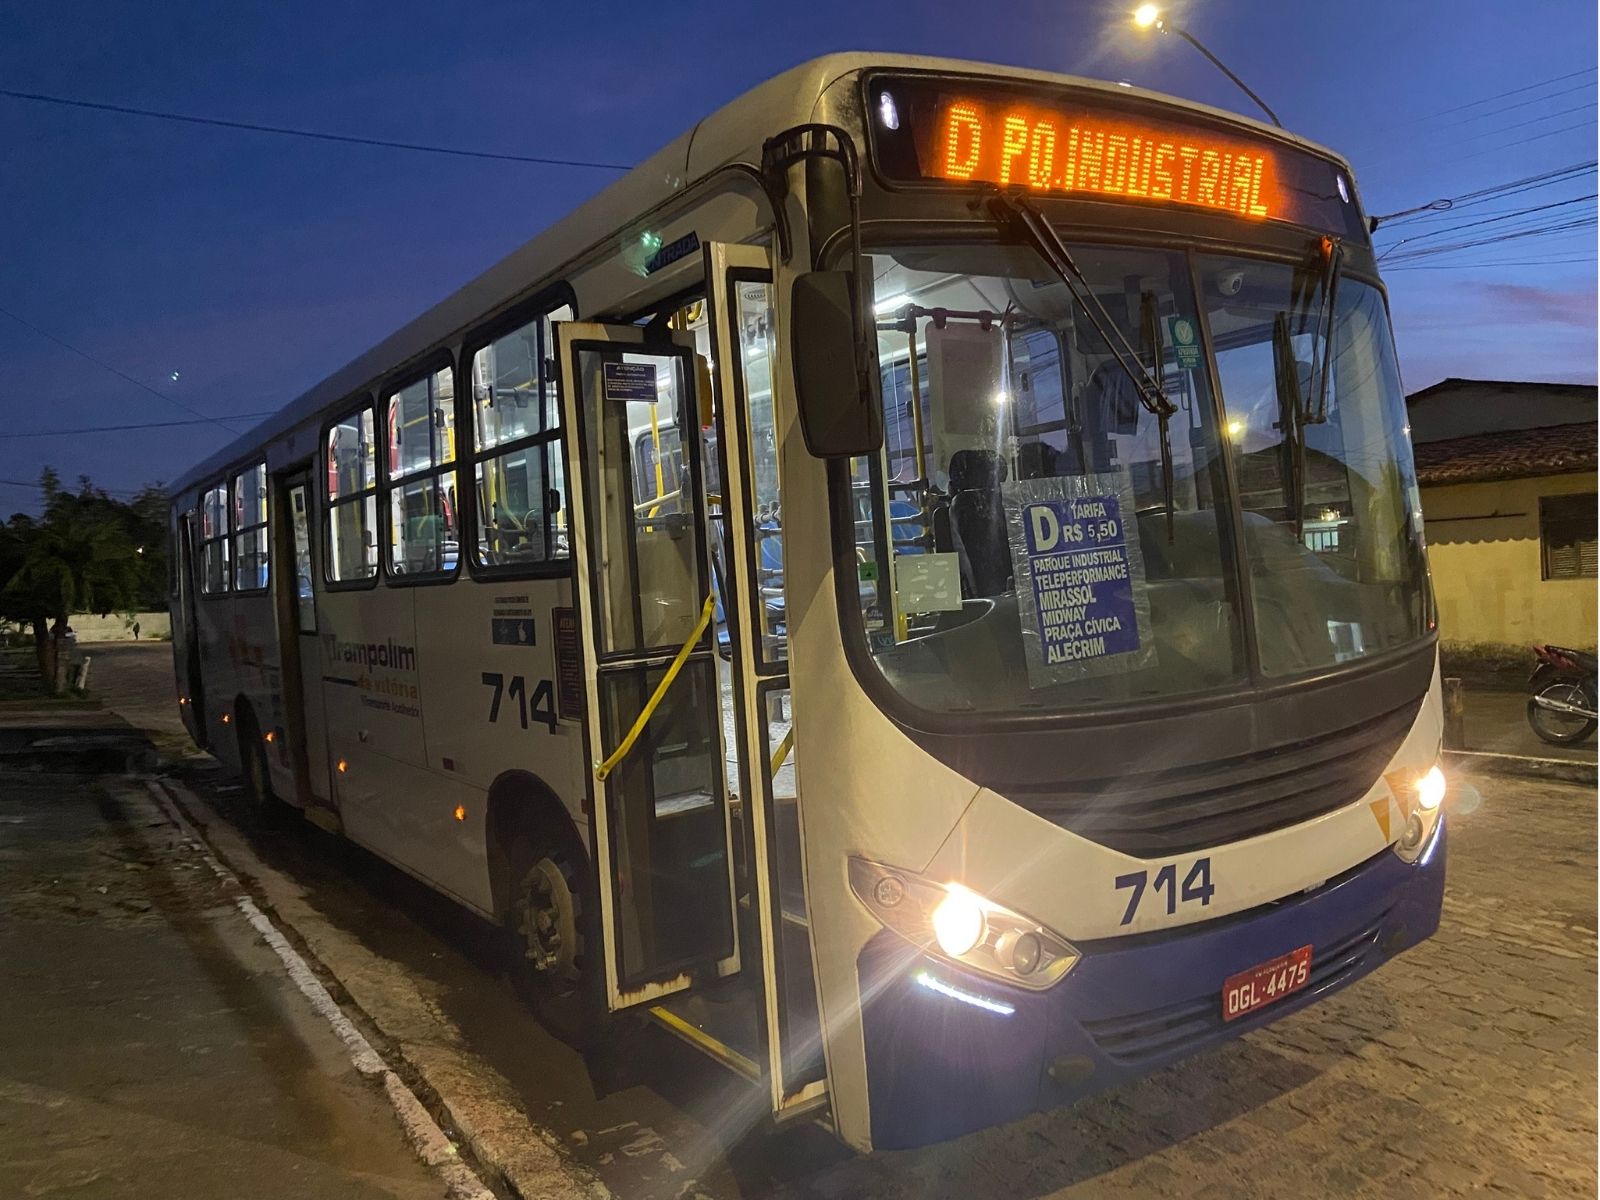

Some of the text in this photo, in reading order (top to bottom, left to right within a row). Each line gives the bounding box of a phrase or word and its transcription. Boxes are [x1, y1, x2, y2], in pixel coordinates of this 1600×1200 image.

[946, 102, 982, 179] D
[1072, 502, 1107, 520] TARIFA
[1030, 506, 1060, 552] D
[1063, 519, 1118, 544] R$ 5,50
[1033, 549, 1124, 573] PARQUE INDUSTRIAL
[1035, 564, 1128, 591] TELEPERFORMANCE
[1039, 585, 1097, 611] MIRASSOL
[1042, 605, 1087, 627] MIDWAY
[1044, 616, 1121, 643] PRAÇA CÍVICA
[323, 633, 416, 674] Trampolim
[1048, 636, 1106, 664] ALECRIM
[482, 672, 560, 735] 714
[1115, 857, 1215, 926] 714
